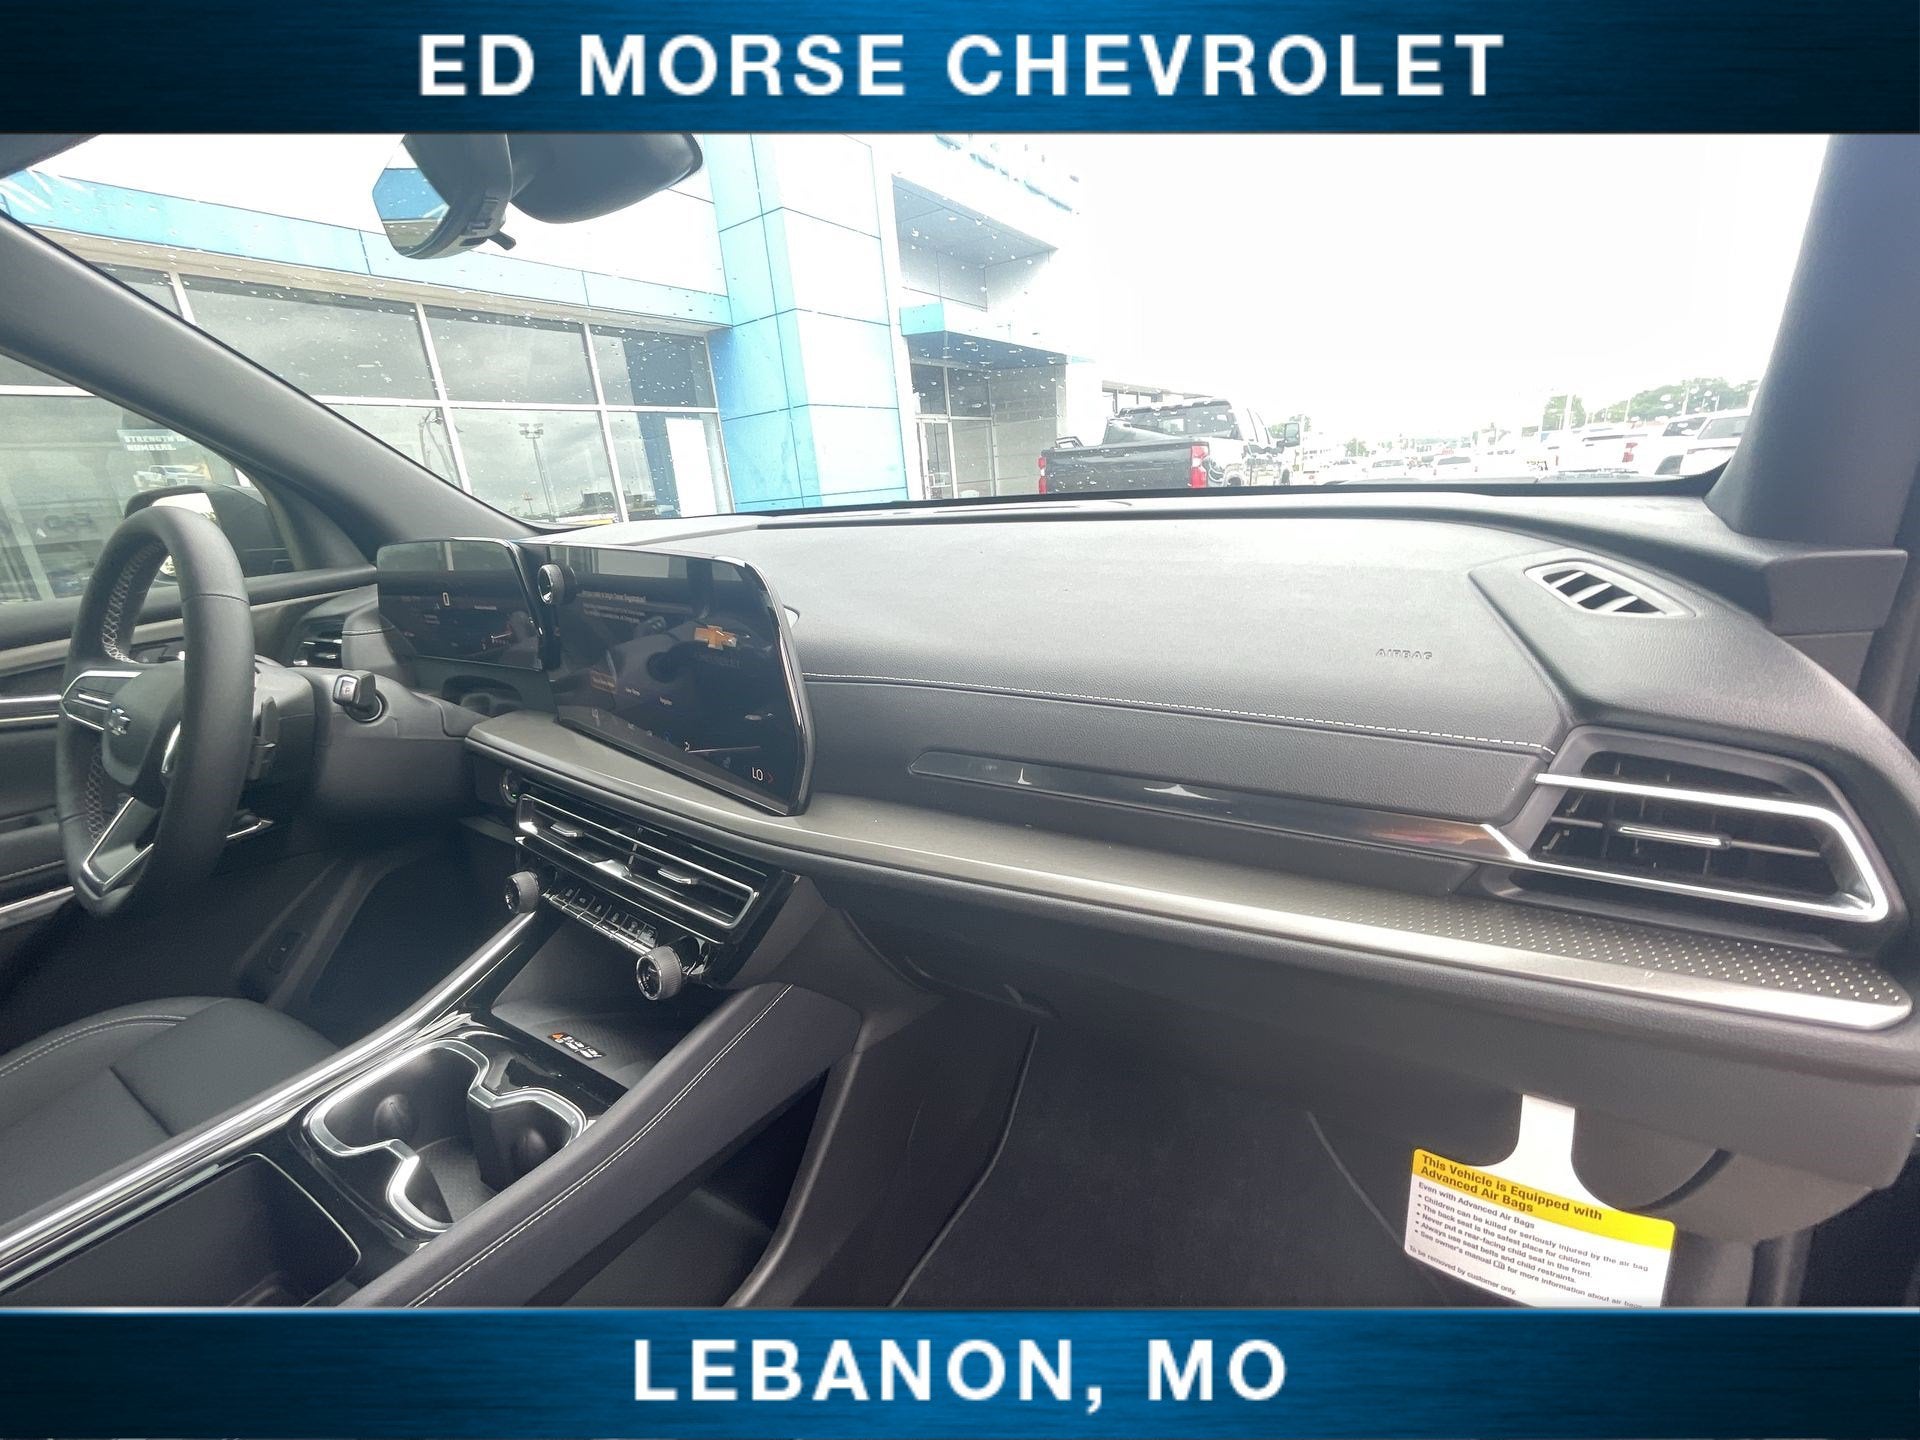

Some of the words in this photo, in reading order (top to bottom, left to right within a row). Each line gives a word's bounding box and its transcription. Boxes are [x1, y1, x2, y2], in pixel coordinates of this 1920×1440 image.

[751, 766, 765, 781] LO
[1419, 1182, 1437, 1194] Even
[1439, 1189, 1456, 1202] with
[1458, 1197, 1497, 1216] Advanced
[1499, 1211, 1512, 1221] Air
[1514, 1216, 1535, 1229] Bags
[1421, 1166, 1478, 1193] Advanced
[1481, 1187, 1500, 1200] Air
[1502, 1194, 1534, 1212] Bags
[1423, 1154, 1446, 1171] This
[1450, 1164, 1493, 1187] Vehicle
[1496, 1181, 1506, 1191] is
[1510, 1185, 1570, 1211] Equipped
[1574, 1206, 1602, 1220] with
[1421, 1222, 1446, 1238] Always
[1448, 1234, 1461, 1243] use
[1463, 1240, 1479, 1250] seat
[1480, 1246, 1499, 1258] belts
[1501, 1254, 1515, 1264] and
[1517, 1259, 1536, 1271] child
[1538, 1267, 1577, 1283] restraints.
[1422, 1214, 1443, 1226] Never
[1444, 1223, 1457, 1233] put
[1464, 1231, 1506, 1252] rear-facing
[1507, 1246, 1527, 1258] child
[1528, 1253, 1545, 1264] seat
[1557, 1262, 1569, 1272] the
[1571, 1267, 1592, 1278] front.
[1423, 1205, 1436, 1214] The
[1438, 1210, 1455, 1222] back
[1457, 1218, 1473, 1229] seat
[1474, 1224, 1481, 1232] is
[1483, 1227, 1495, 1237] the
[1497, 1232, 1520, 1246] safest
[1522, 1241, 1543, 1253] place
[1545, 1249, 1556, 1257] for
[1559, 1254, 1591, 1267] children
[1424, 1196, 1455, 1213] Children
[1457, 1209, 1471, 1219] can
[1473, 1213, 1483, 1223] be
[1485, 1218, 1507, 1231] killed
[1509, 1227, 1517, 1235] or
[1519, 1230, 1556, 1248] seriously
[1559, 1243, 1588, 1257] injured
[1590, 1252, 1600, 1261] by
[1603, 1256, 1617, 1264] the
[1633, 1263, 1648, 1272] bag
[1409, 1245, 1417, 1253] To
[1418, 1249, 1426, 1257] be
[1427, 1254, 1456, 1271] removed
[1457, 1267, 1466, 1276] by
[1467, 1272, 1499, 1288] customer
[1500, 1284, 1517, 1296] only.
[1420, 1231, 1433, 1241] See
[1435, 1238, 1463, 1254] owner's
[1465, 1250, 1492, 1265] manual
[1507, 1266, 1518, 1275] for
[1519, 1271, 1540, 1282] more
[1541, 1278, 1586, 1296] information
[1588, 1292, 1610, 1302] about
